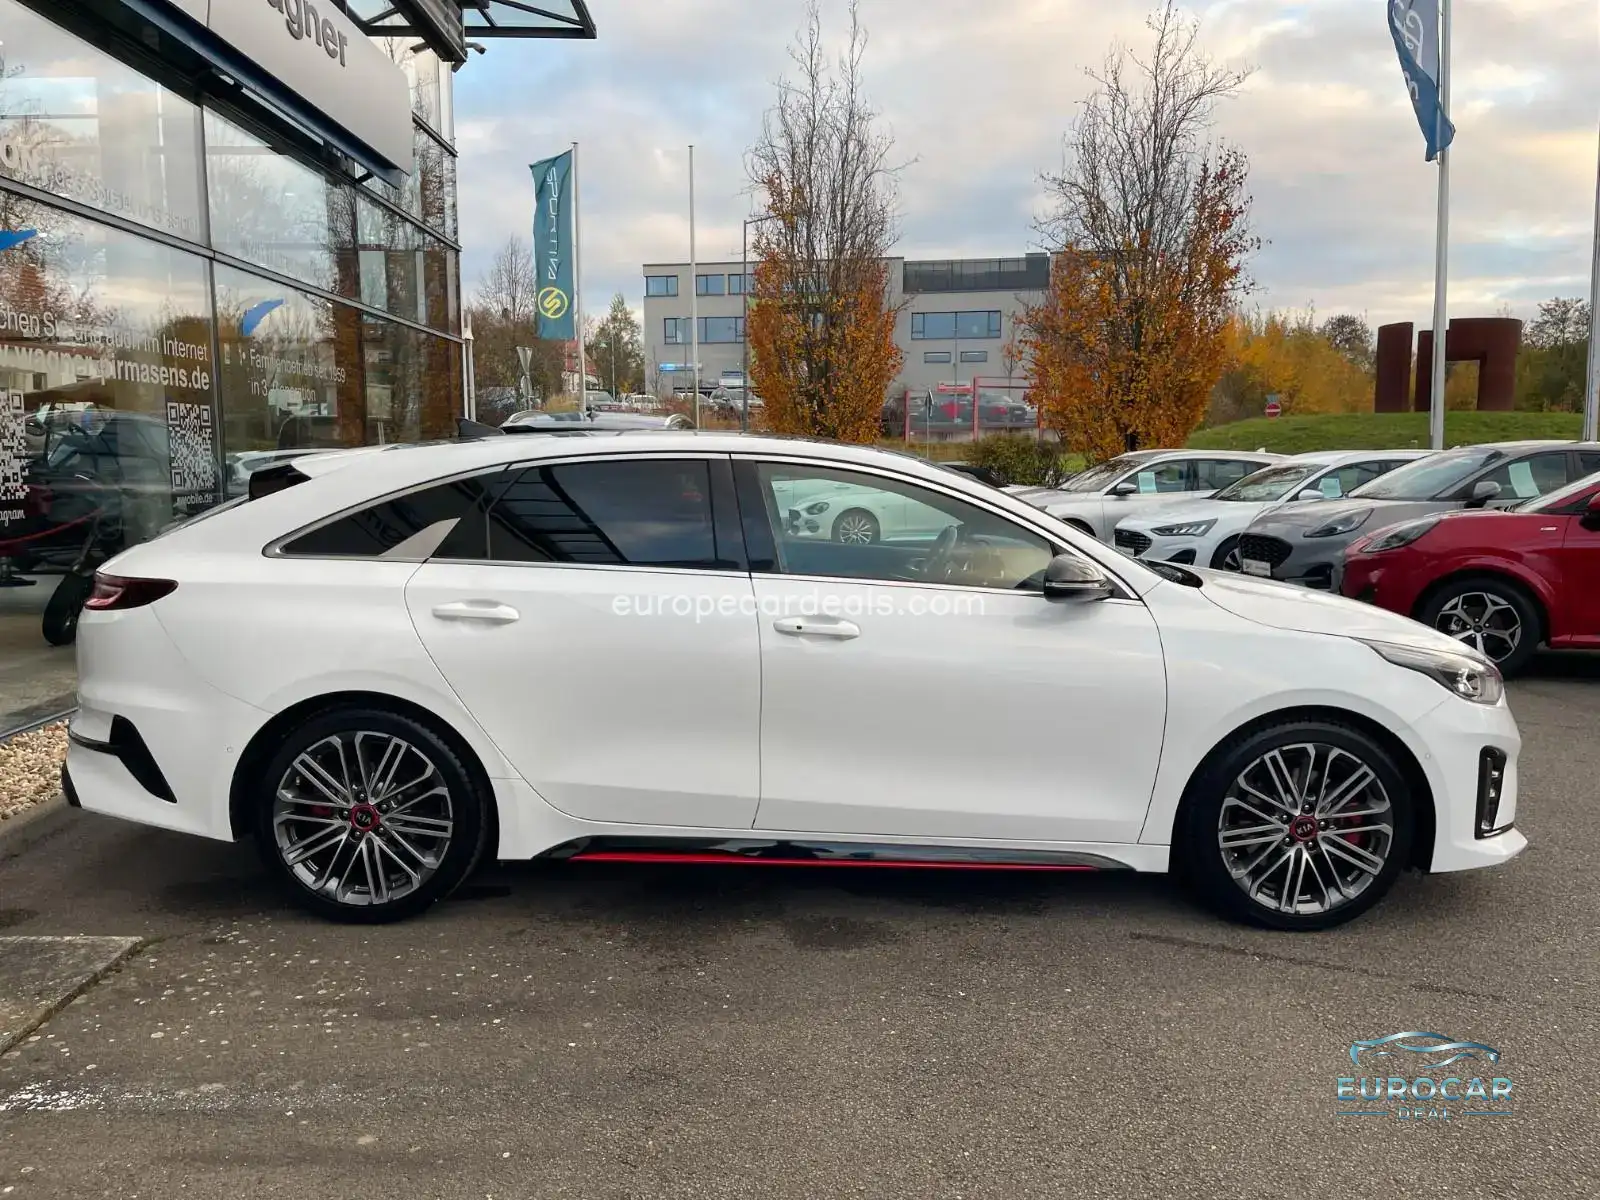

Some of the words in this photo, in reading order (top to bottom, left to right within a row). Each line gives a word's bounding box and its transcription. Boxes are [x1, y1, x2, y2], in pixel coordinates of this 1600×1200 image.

[267, 0, 348, 67] gner
[163, 334, 209, 361] Internet
[1296, 823, 1313, 835] KIA
